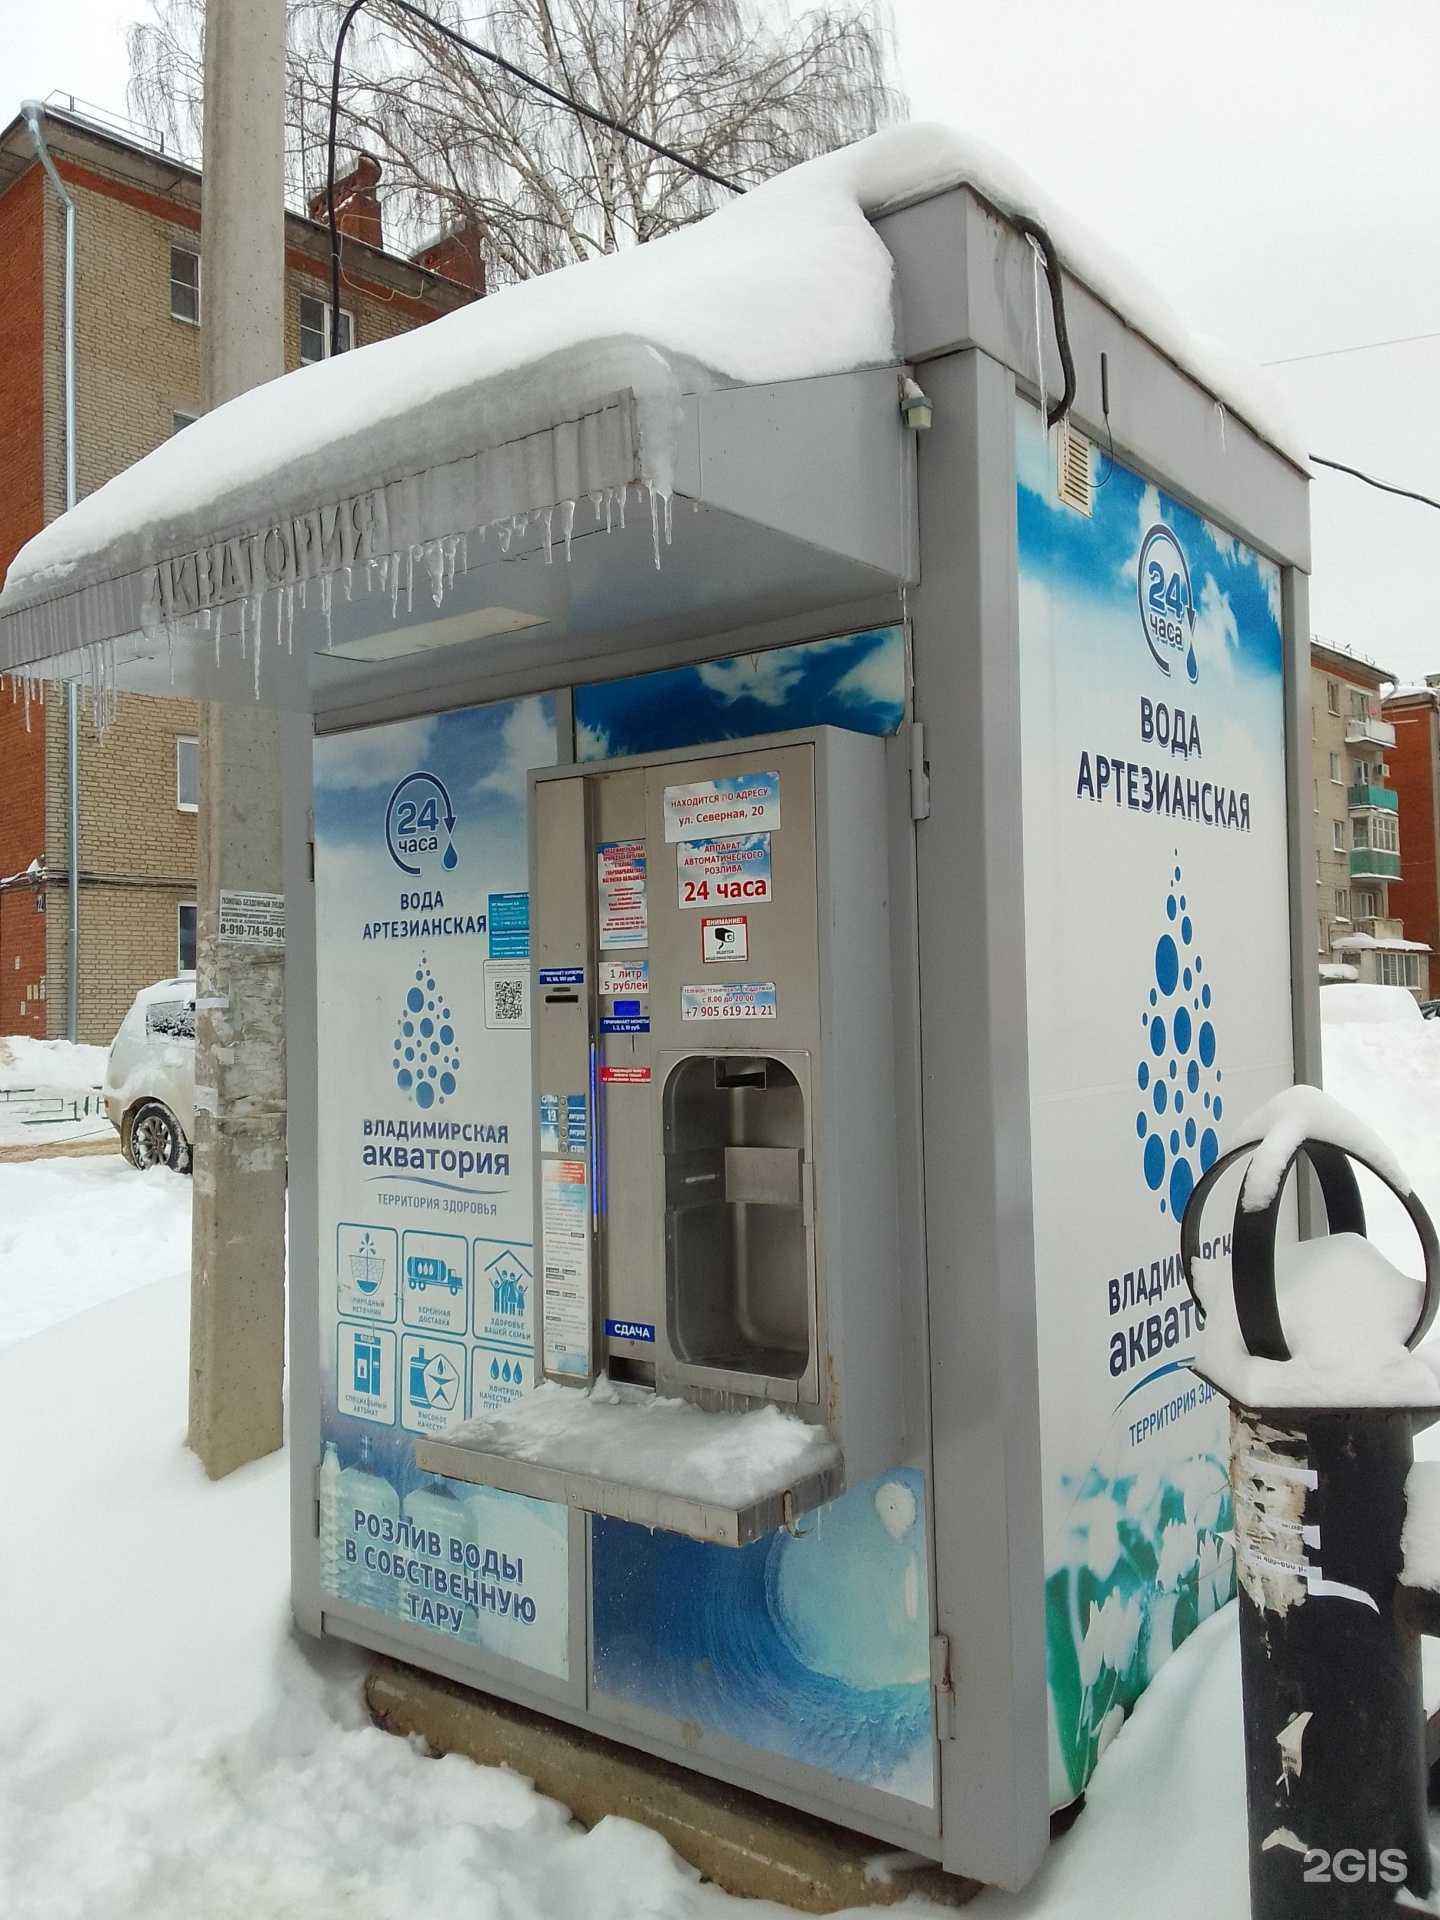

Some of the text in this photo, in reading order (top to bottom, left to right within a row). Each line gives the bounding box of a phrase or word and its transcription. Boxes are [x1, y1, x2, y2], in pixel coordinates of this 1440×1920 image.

[1148, 561, 1183, 620] 24
[1149, 613, 1183, 649] часа
[1140, 697, 1201, 758] ВОДА
[671, 795, 720, 808] НАХОДИТСЯ
[736, 788, 768, 800] АДРЕСУ
[1077, 751, 1251, 831] АРТЕЗИАНСКАЯ
[397, 799, 439, 834] 24
[679, 806, 764, 827] ул. Северная, 20
[398, 836, 438, 853] часа
[704, 842, 741, 853] АППАРАТ
[684, 850, 764, 866] АВТОМАТИЧЕСКОГО
[704, 864, 742, 875] РОЗЛИВА
[400, 891, 444, 911] ВОДА
[684, 879, 768, 902] 24 часа
[363, 915, 487, 940] АРТЕЗИАНСКАЯ
[604, 979, 648, 992] 5 рублей
[610, 969, 642, 980] 1 литр
[701, 1006, 720, 1017] 905
[722, 1005, 742, 1016] 619
[744, 1005, 757, 1016] 21
[760, 1004, 773, 1016] 21
[363, 1118, 509, 1143] ВЛАДИМИРСКАЯ
[362, 1144, 510, 1178] акватория
[377, 1193, 498, 1216] ТЕРРИТОРИЯ ЗДОРОВЬЯ
[614, 1323, 651, 1338] СДАЧА
[1129, 1389, 1197, 1447] ТЕРРИТОРИЯ
[354, 1508, 524, 1584] РОЗЛИВ ВОДЫ
[345, 1538, 537, 1625] В СОБСТВЕННУЮ
[407, 1592, 464, 1633] ТАРУ
